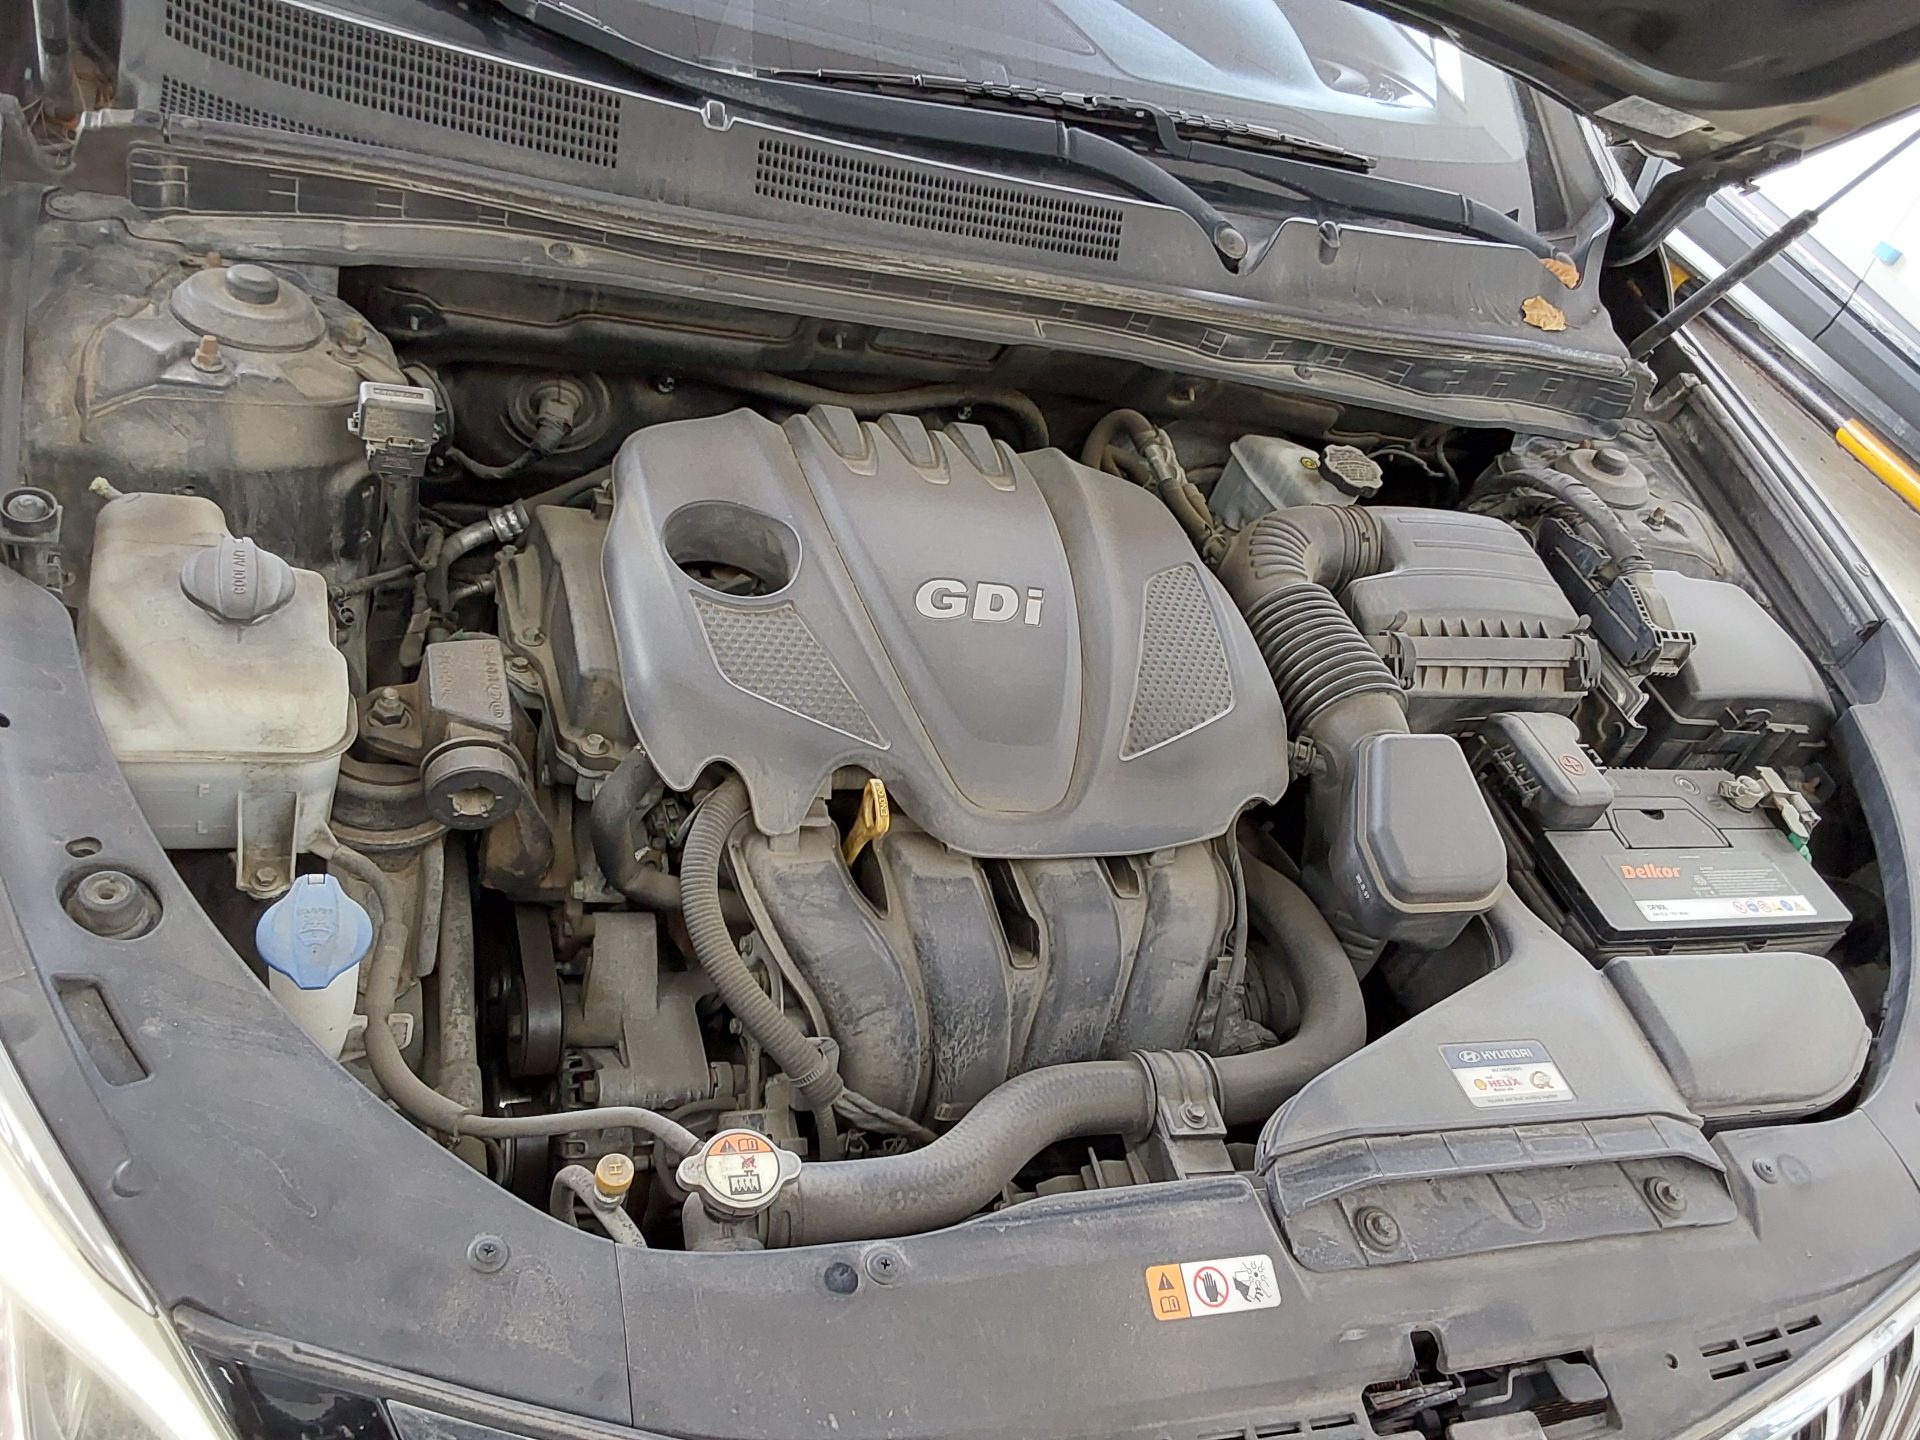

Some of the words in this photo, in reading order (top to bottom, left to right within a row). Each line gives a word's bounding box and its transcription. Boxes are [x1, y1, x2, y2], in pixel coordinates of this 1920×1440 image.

[233, 550, 246, 595] COOLANT
[914, 577, 1044, 627] GDi
[879, 797, 889, 817] ENG
[1620, 863, 1681, 880] Delkor
[1480, 1047, 1533, 1062] HYUNDAI
